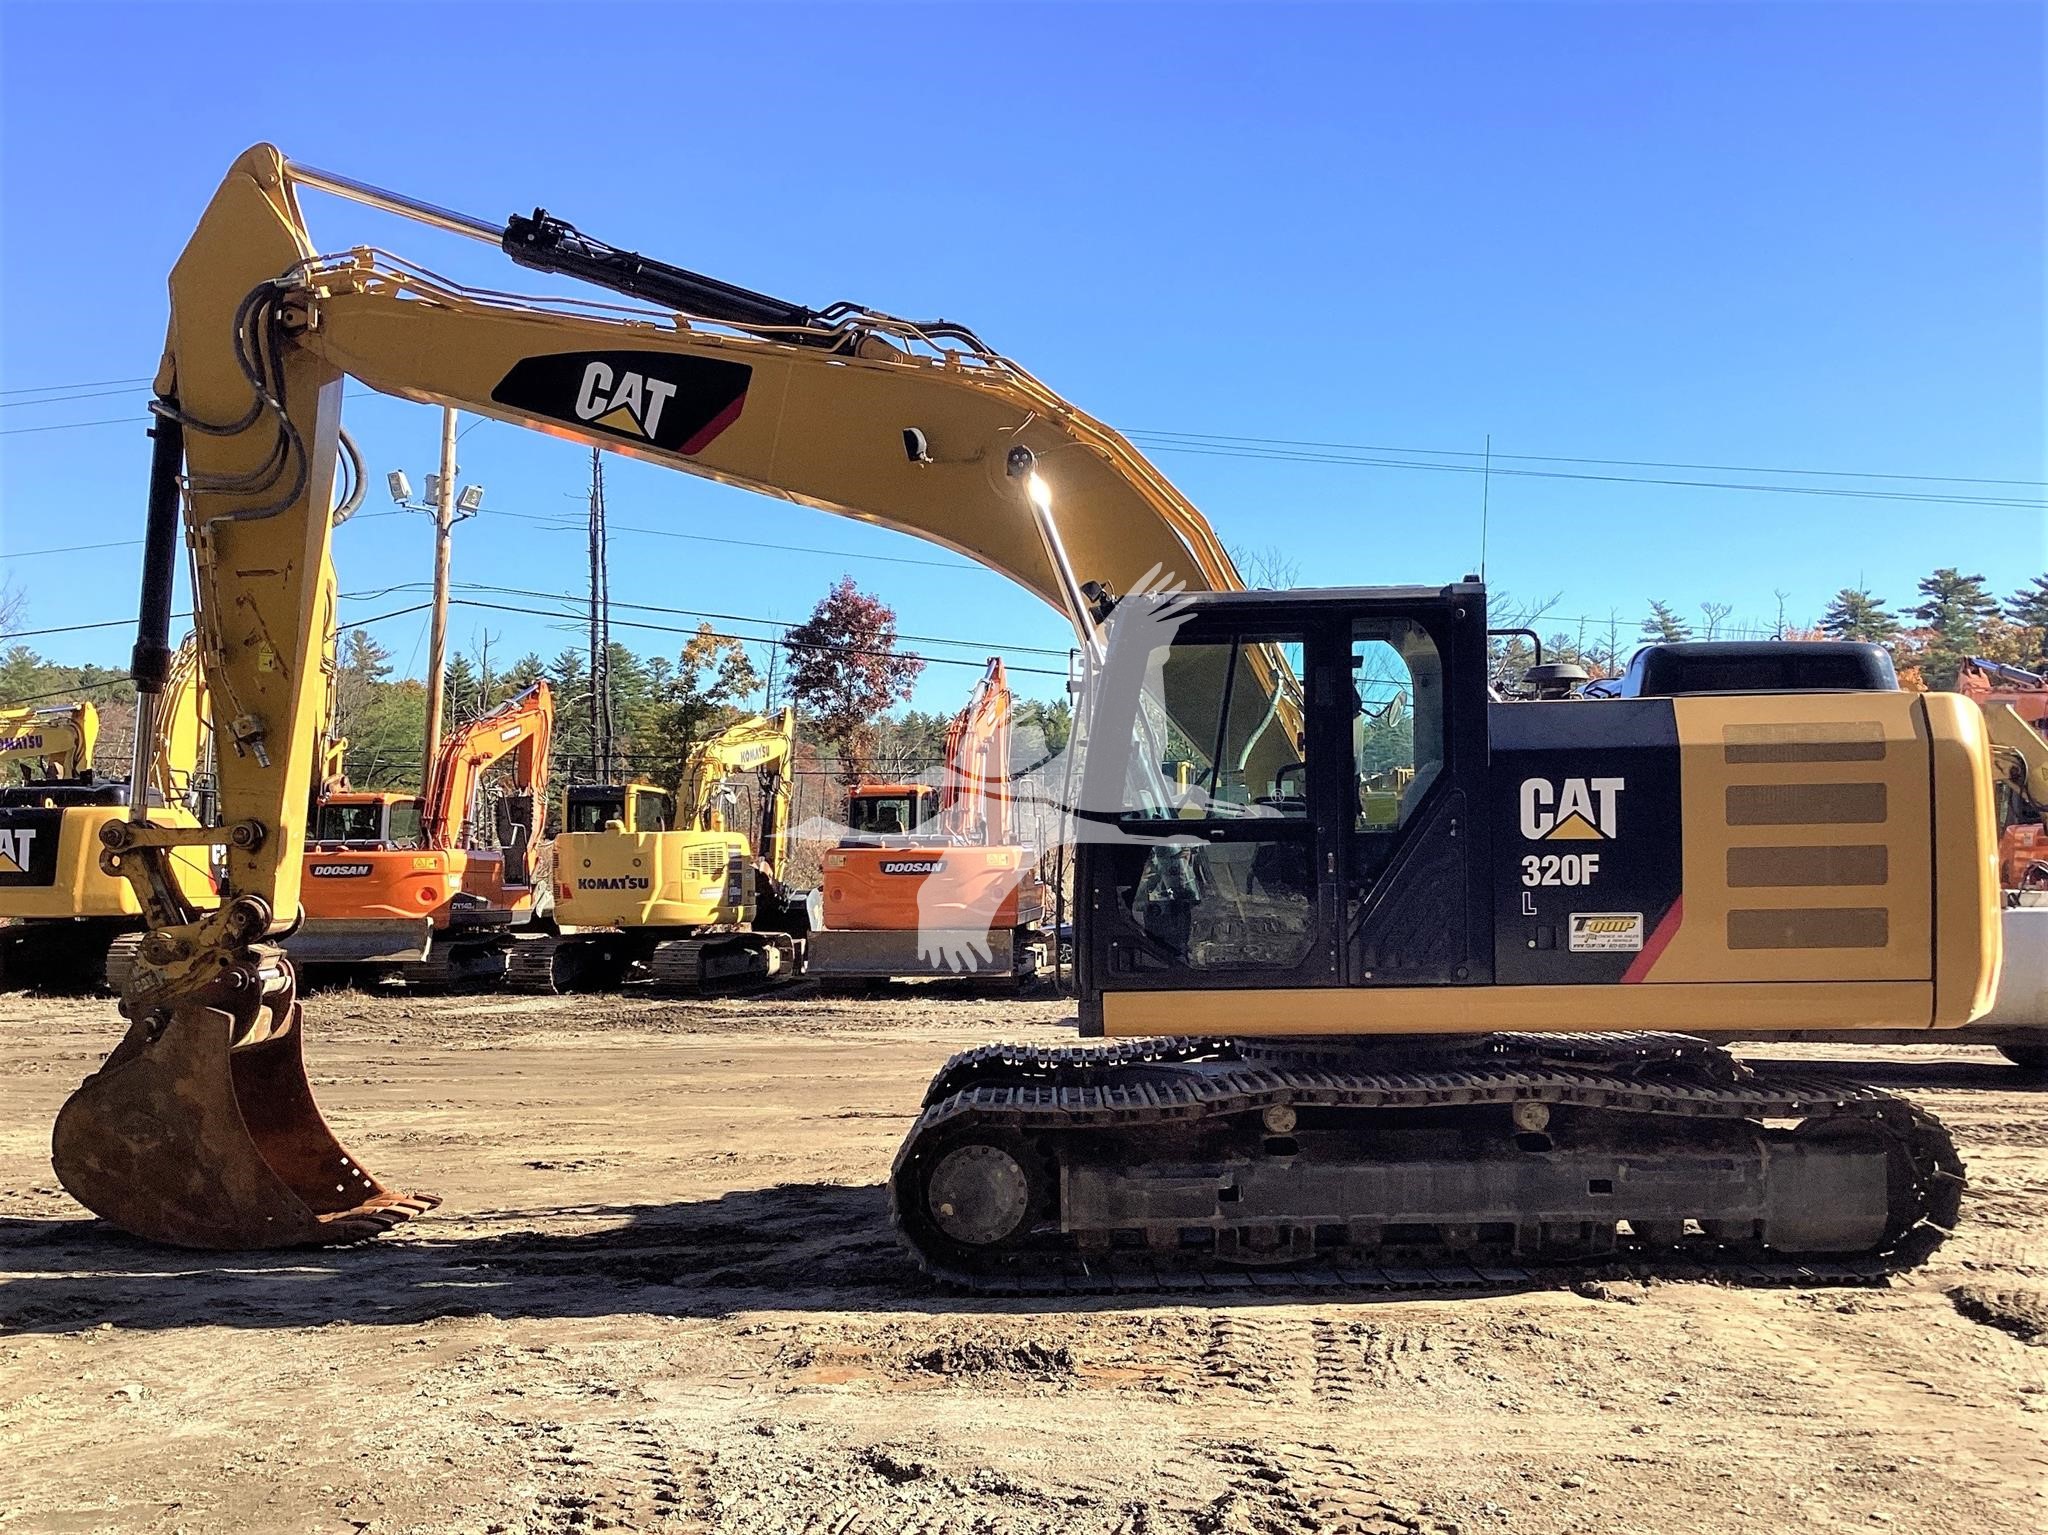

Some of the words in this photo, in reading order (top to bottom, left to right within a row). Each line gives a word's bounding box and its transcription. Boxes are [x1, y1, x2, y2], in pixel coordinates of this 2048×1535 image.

[575, 361, 677, 440] CAT
[0, 735, 43, 751] OMATSU
[740, 744, 770, 763] KOMATSU
[1520, 777, 1624, 840] CAT
[0, 828, 37, 872] AT
[314, 865, 369, 876] DOOSAN
[885, 863, 943, 873] DOOSAN
[1521, 854, 1599, 886] 320F
[578, 875, 649, 890] KOMATSU
[1522, 891, 1537, 916] L
